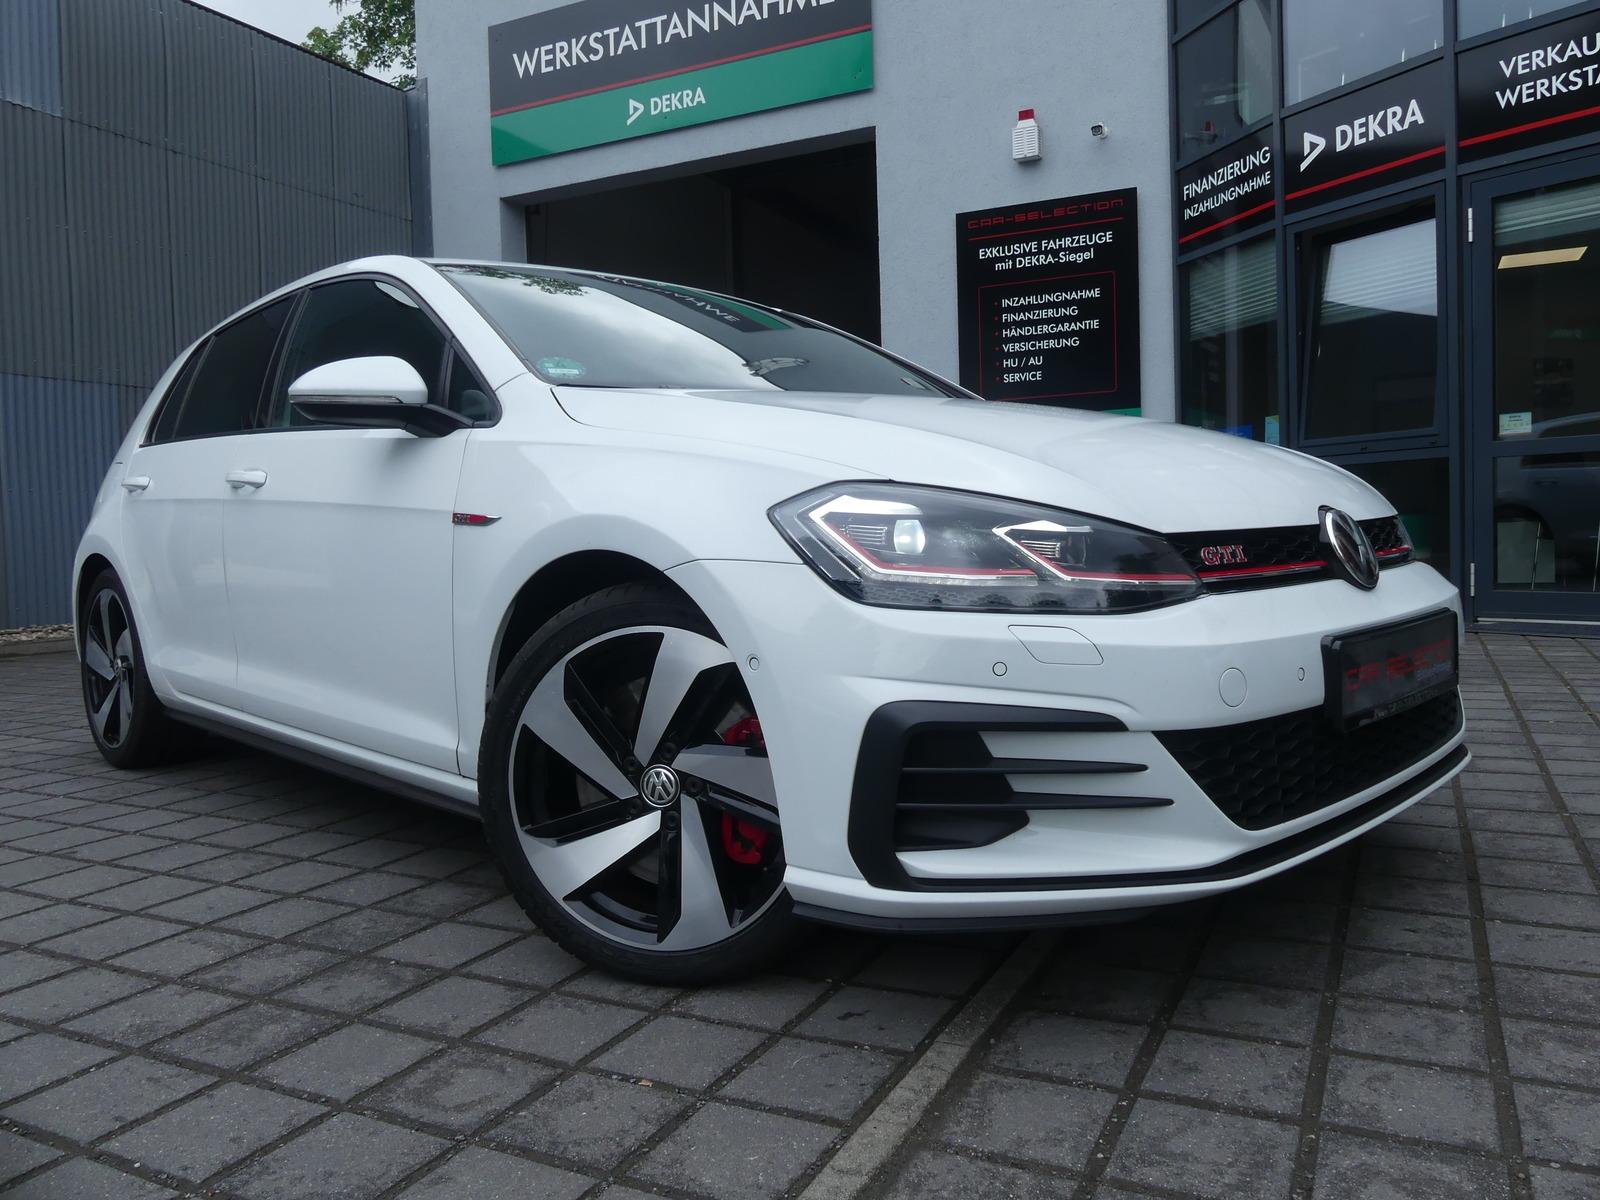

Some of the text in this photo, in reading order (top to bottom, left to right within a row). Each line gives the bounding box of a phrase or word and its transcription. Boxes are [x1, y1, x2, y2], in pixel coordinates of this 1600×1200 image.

[512, 0, 835, 79] WERKSTATTANNAH
[1495, 64, 1600, 109] WERKST
[650, 86, 706, 116] DEKRA
[1335, 99, 1424, 152] DEKRA
[1183, 146, 1271, 201] FINANZIERUNG
[1184, 171, 1271, 221] INZAHLUNGNAHME
[978, 231, 1113, 260] EXKLUSIVE FAHRZEUGE
[995, 248, 1094, 271] mit DEKRA-Siegel
[1002, 288, 1101, 308] INZAHLUNGNAHME
[1002, 306, 1079, 323] FINANZIERUNG
[1002, 319, 1100, 338] HÄNDLERGARANTIE
[1002, 337, 1080, 352] VERSICHERUNG
[1003, 358, 1018, 368] HU
[1028, 356, 1043, 366] AU
[1003, 371, 1042, 383] SERVICE
[1200, 544, 1248, 566] GTI
